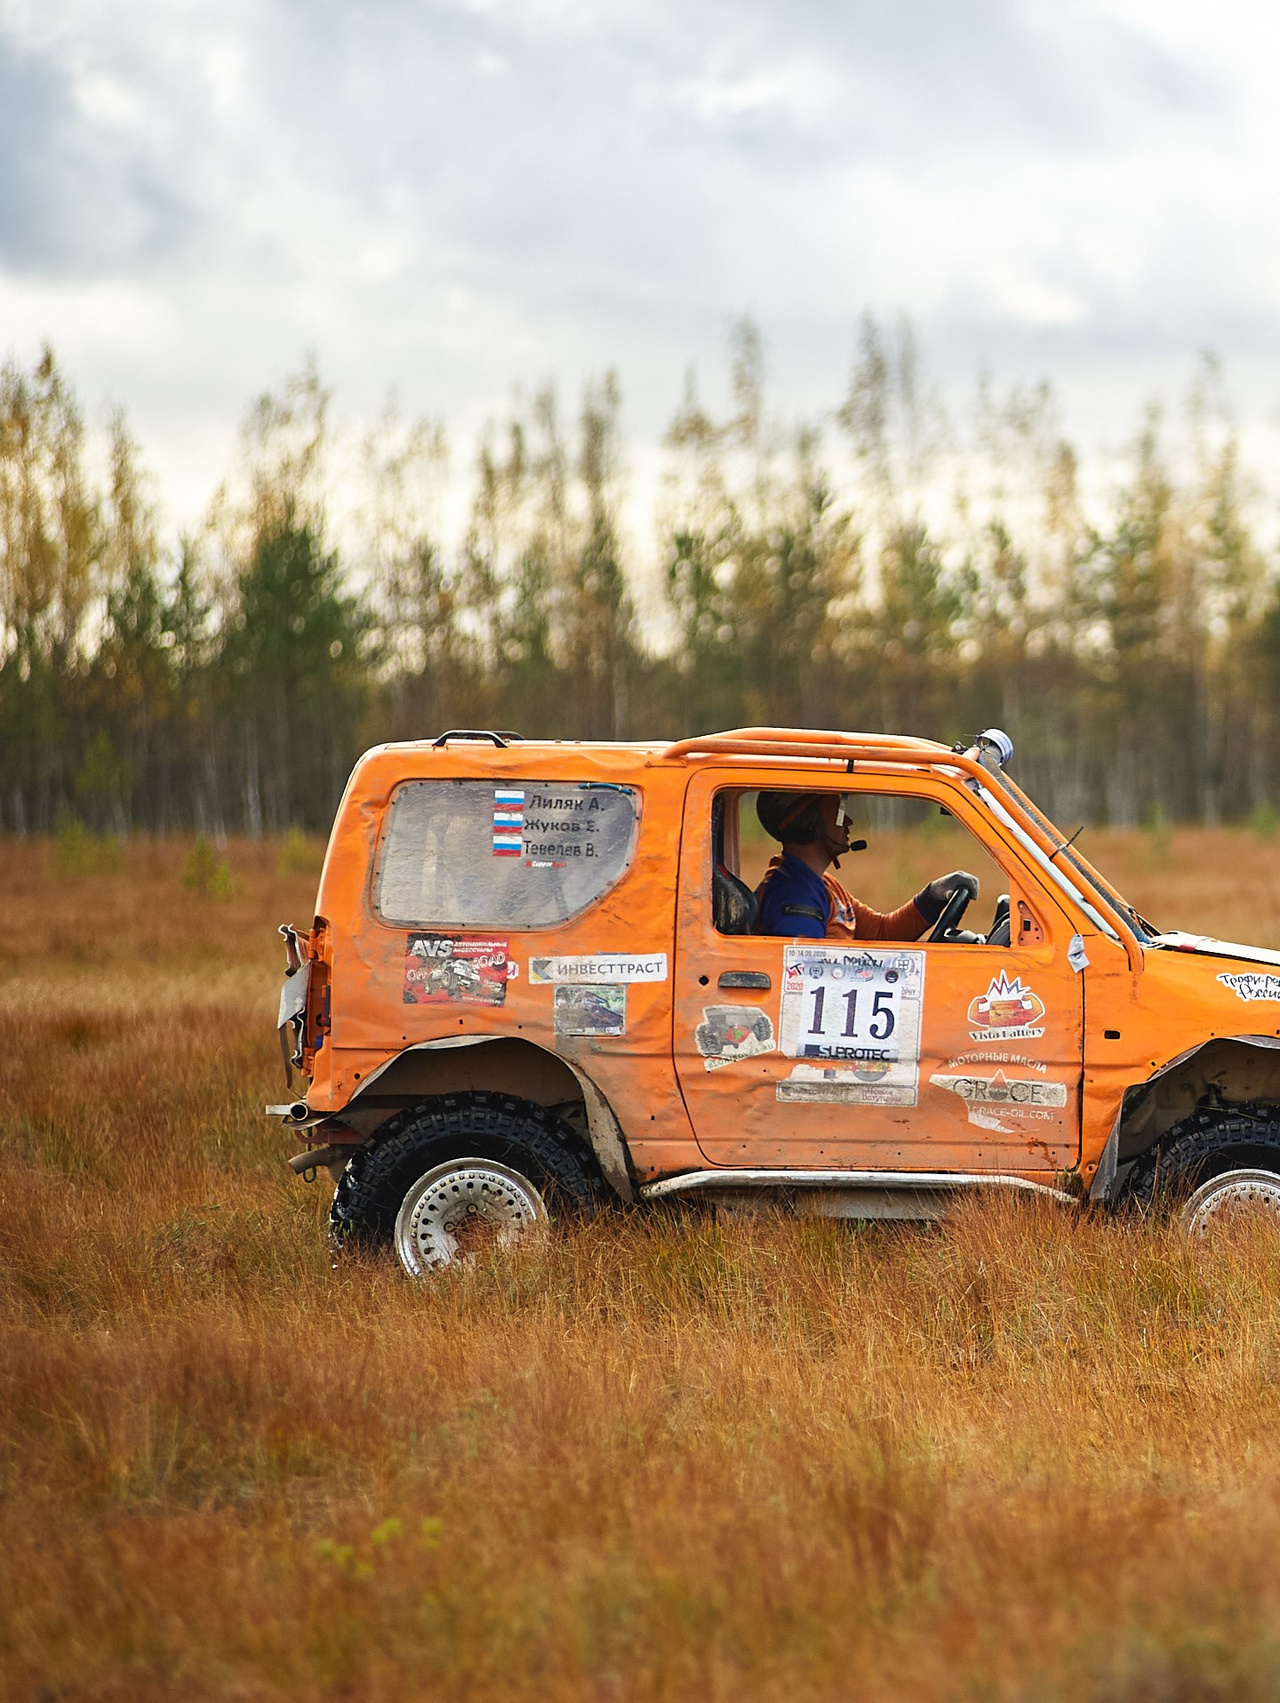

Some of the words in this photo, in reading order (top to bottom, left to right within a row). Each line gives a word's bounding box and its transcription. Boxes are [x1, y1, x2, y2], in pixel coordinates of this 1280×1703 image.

[523, 818, 581, 833] Жуков
[523, 840, 581, 857] Тевелев
[410, 939, 454, 958] AVS
[557, 961, 664, 976] ИНВЕСТТРАСТ
[807, 985, 895, 1040] 115
[948, 1052, 1009, 1069] МОТОРНЫЕ
[1010, 1055, 1048, 1074] МАСЛА
